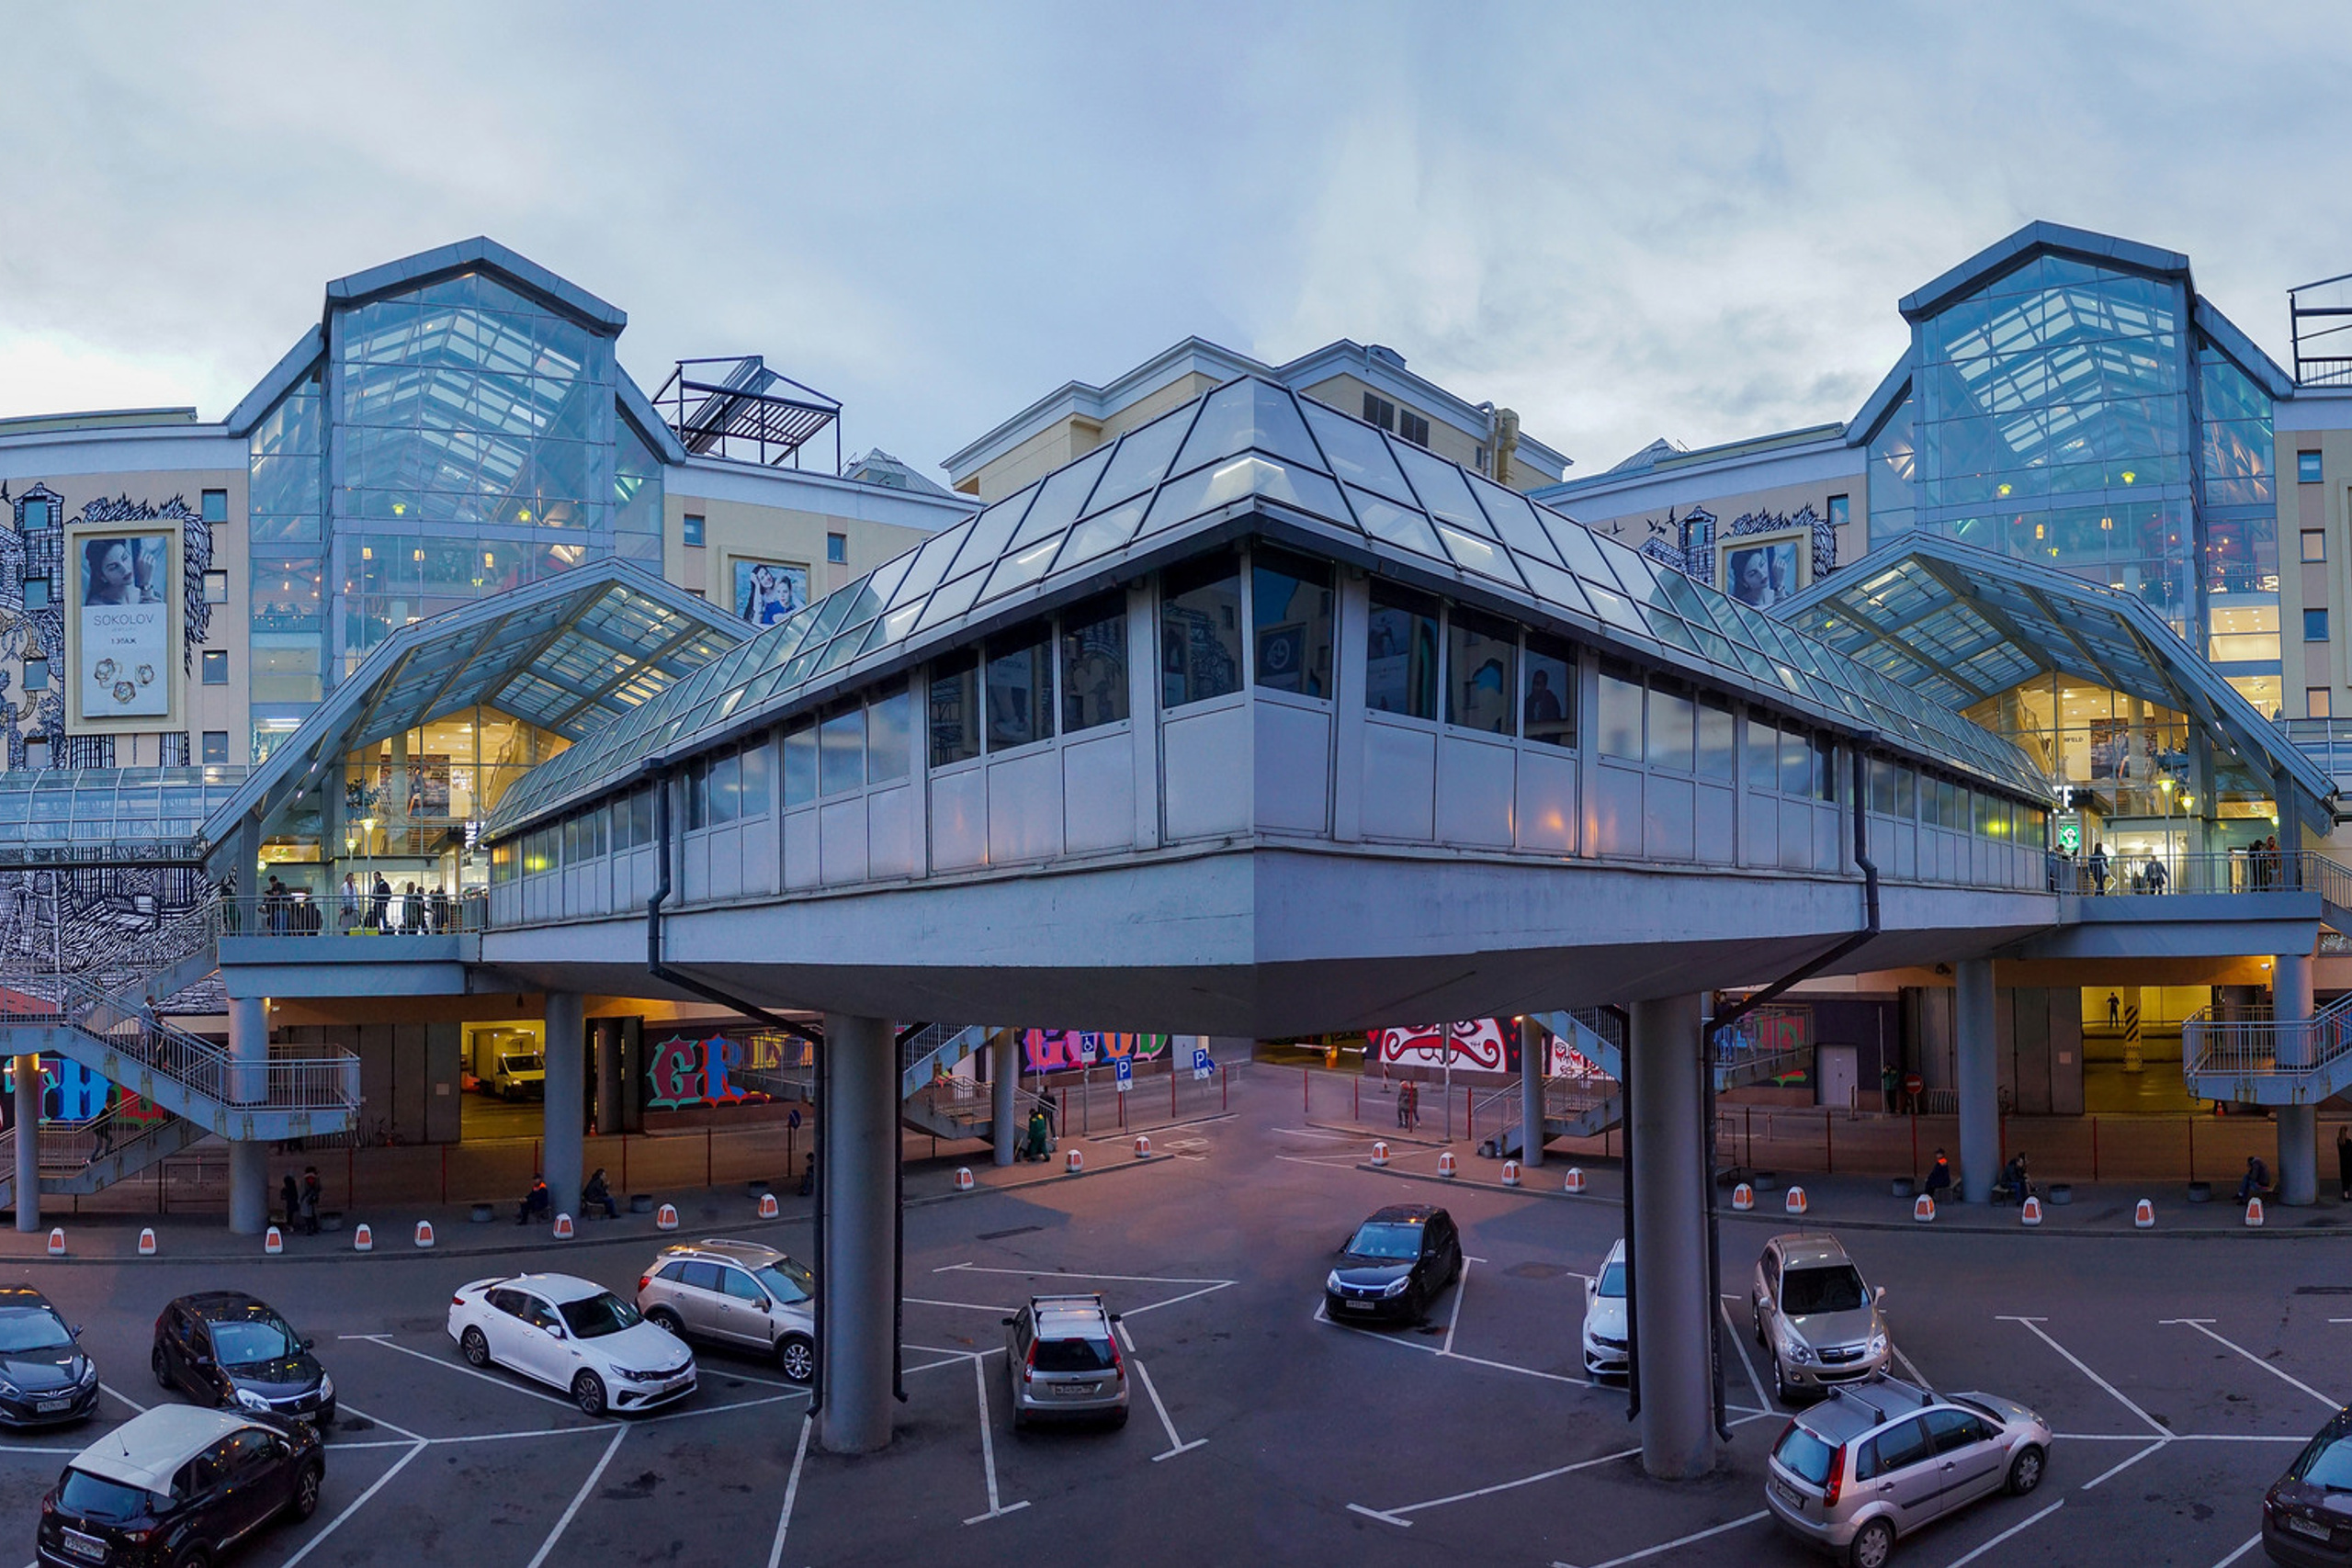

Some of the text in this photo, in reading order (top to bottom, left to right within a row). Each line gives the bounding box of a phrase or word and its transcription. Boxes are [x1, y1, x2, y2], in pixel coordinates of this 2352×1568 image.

[94, 614, 153, 626] SOKOLOV
[1196, 1051, 1205, 1066] P
[1119, 1062, 1129, 1078] P
